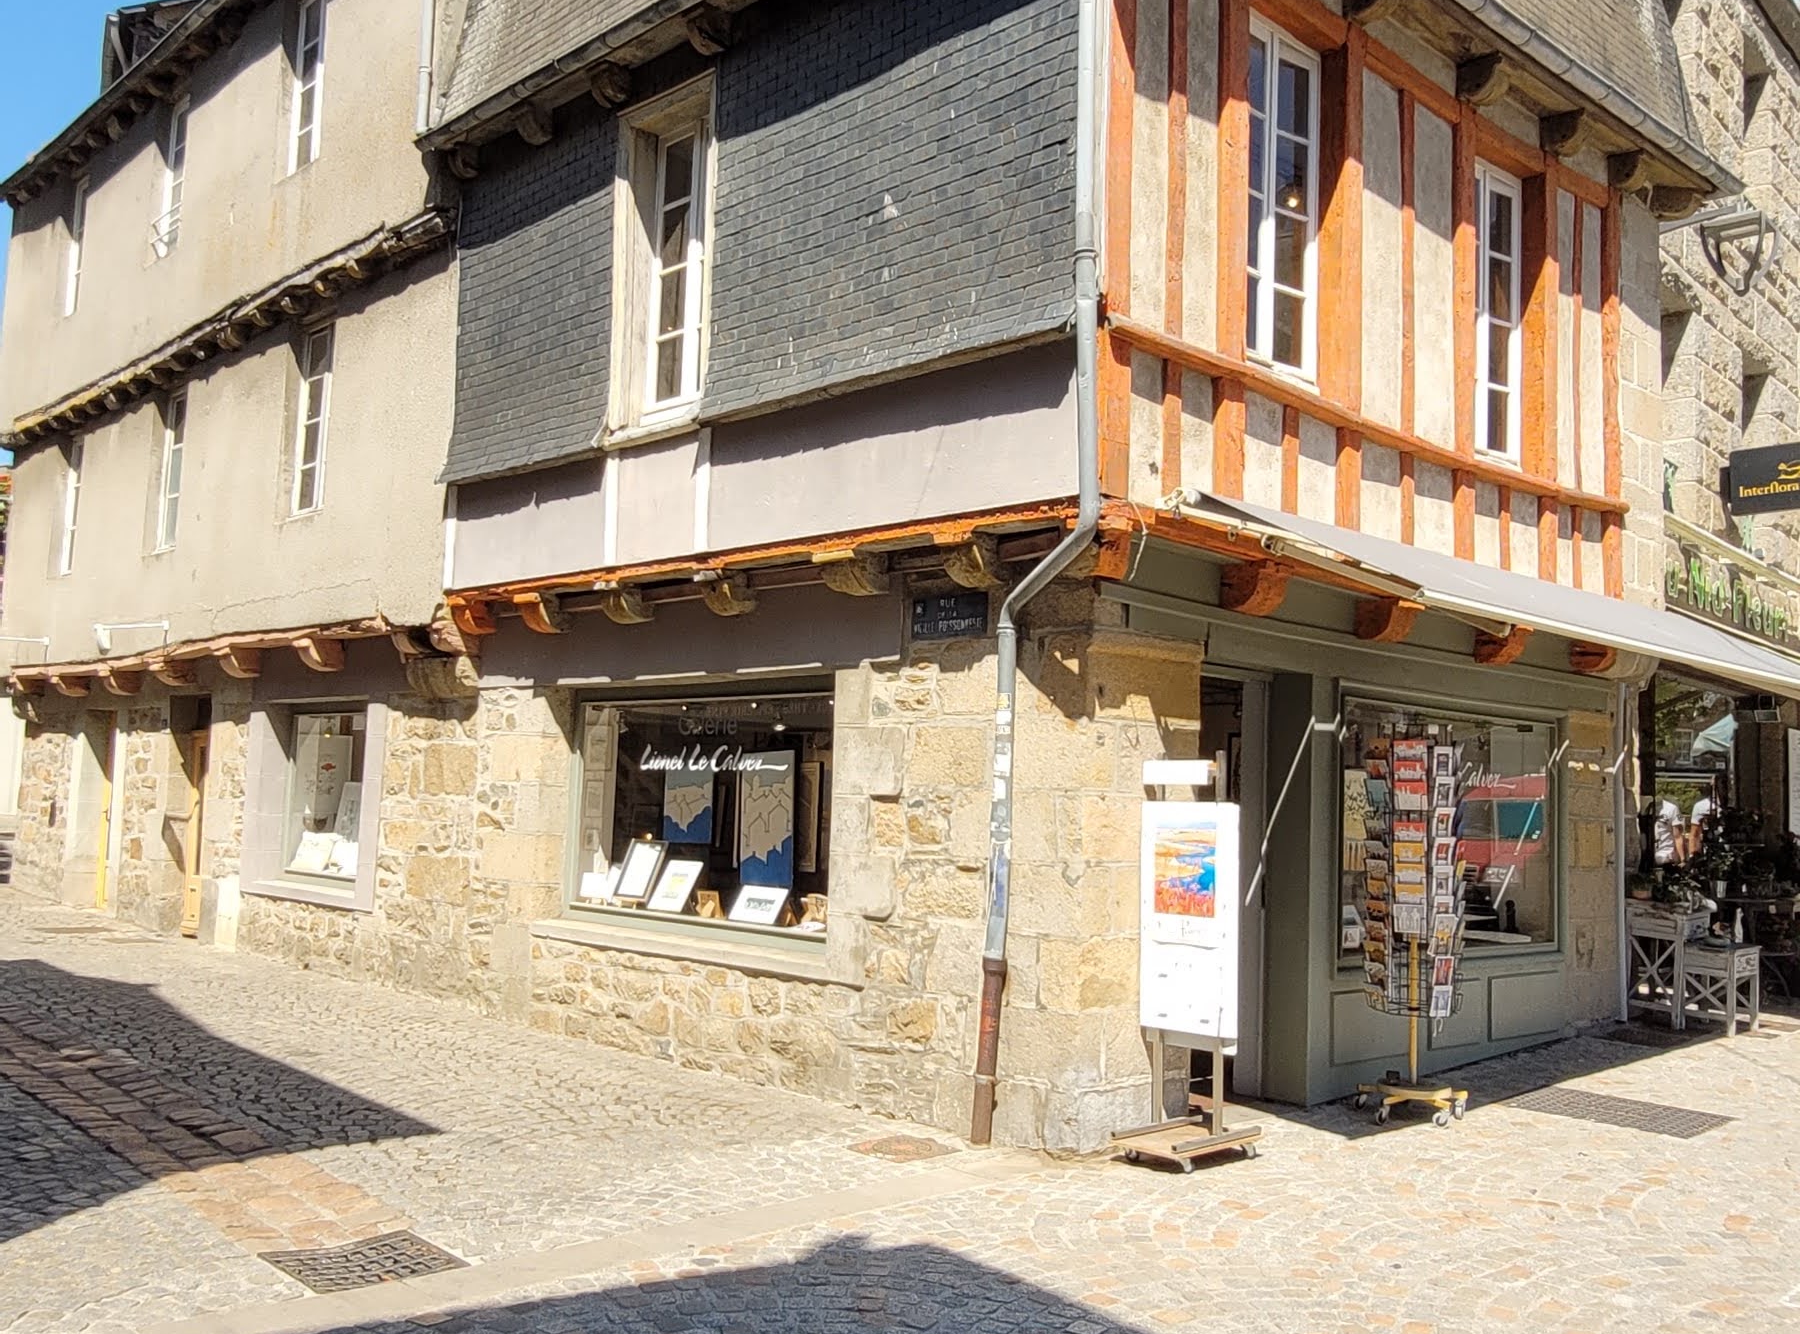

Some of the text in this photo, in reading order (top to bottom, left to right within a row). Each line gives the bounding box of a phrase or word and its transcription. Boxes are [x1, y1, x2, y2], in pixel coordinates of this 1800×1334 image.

[1739, 480, 1800, 498] Interflora
[940, 598, 956, 608] RUE
[1688, 556, 1727, 617] Nid
[1733, 579, 1790, 642] Fleuri
[640, 743, 789, 772] Lionel Le Calvez
